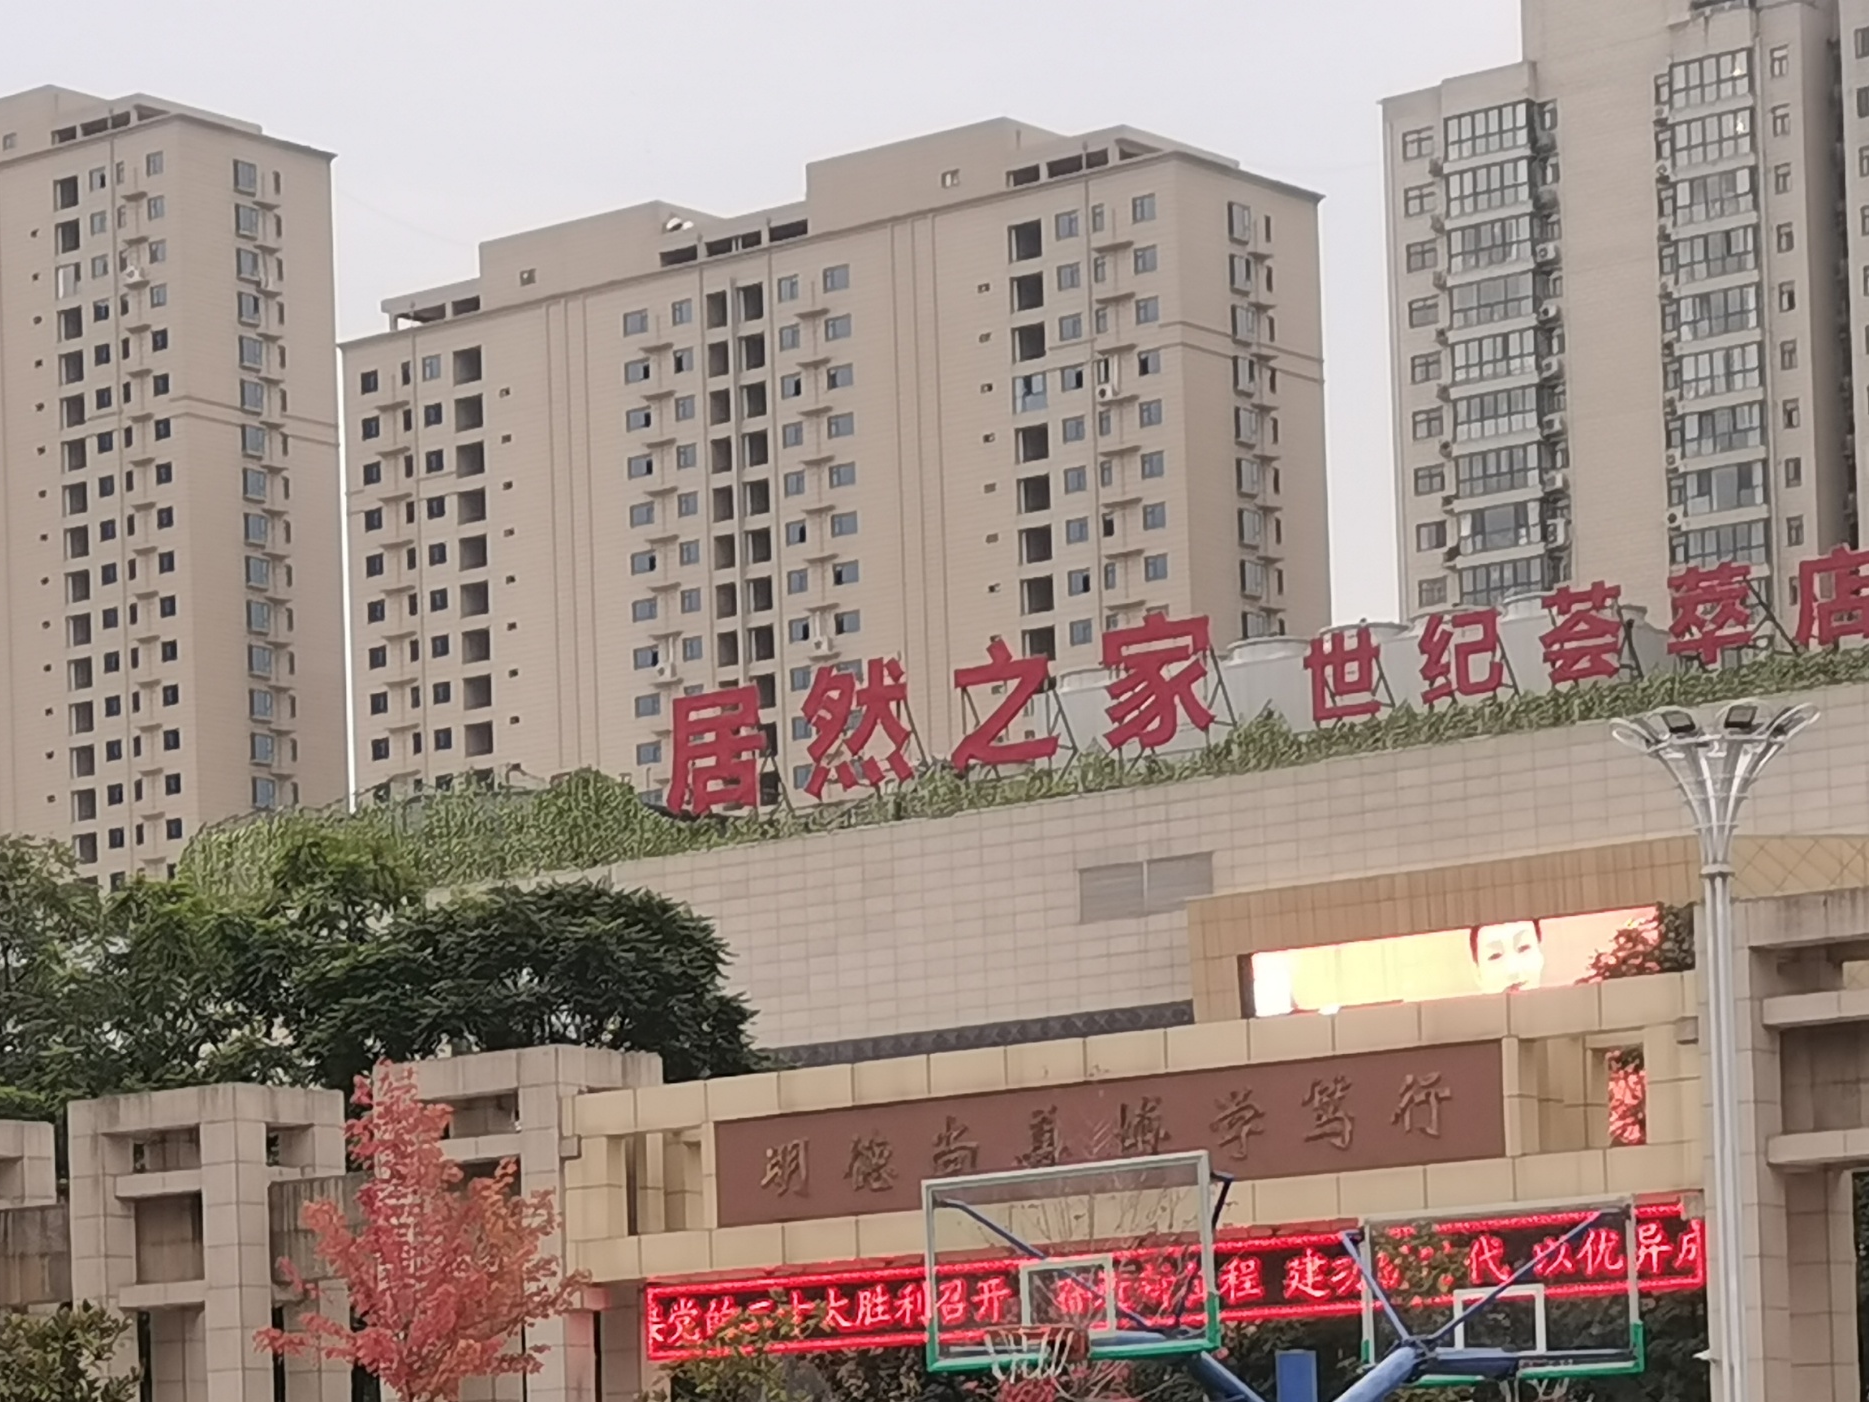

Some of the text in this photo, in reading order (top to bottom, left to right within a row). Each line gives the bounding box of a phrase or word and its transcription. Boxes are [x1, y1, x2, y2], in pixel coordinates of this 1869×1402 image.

[666, 545, 1869, 815] 居然之家 世纪荟萃店
